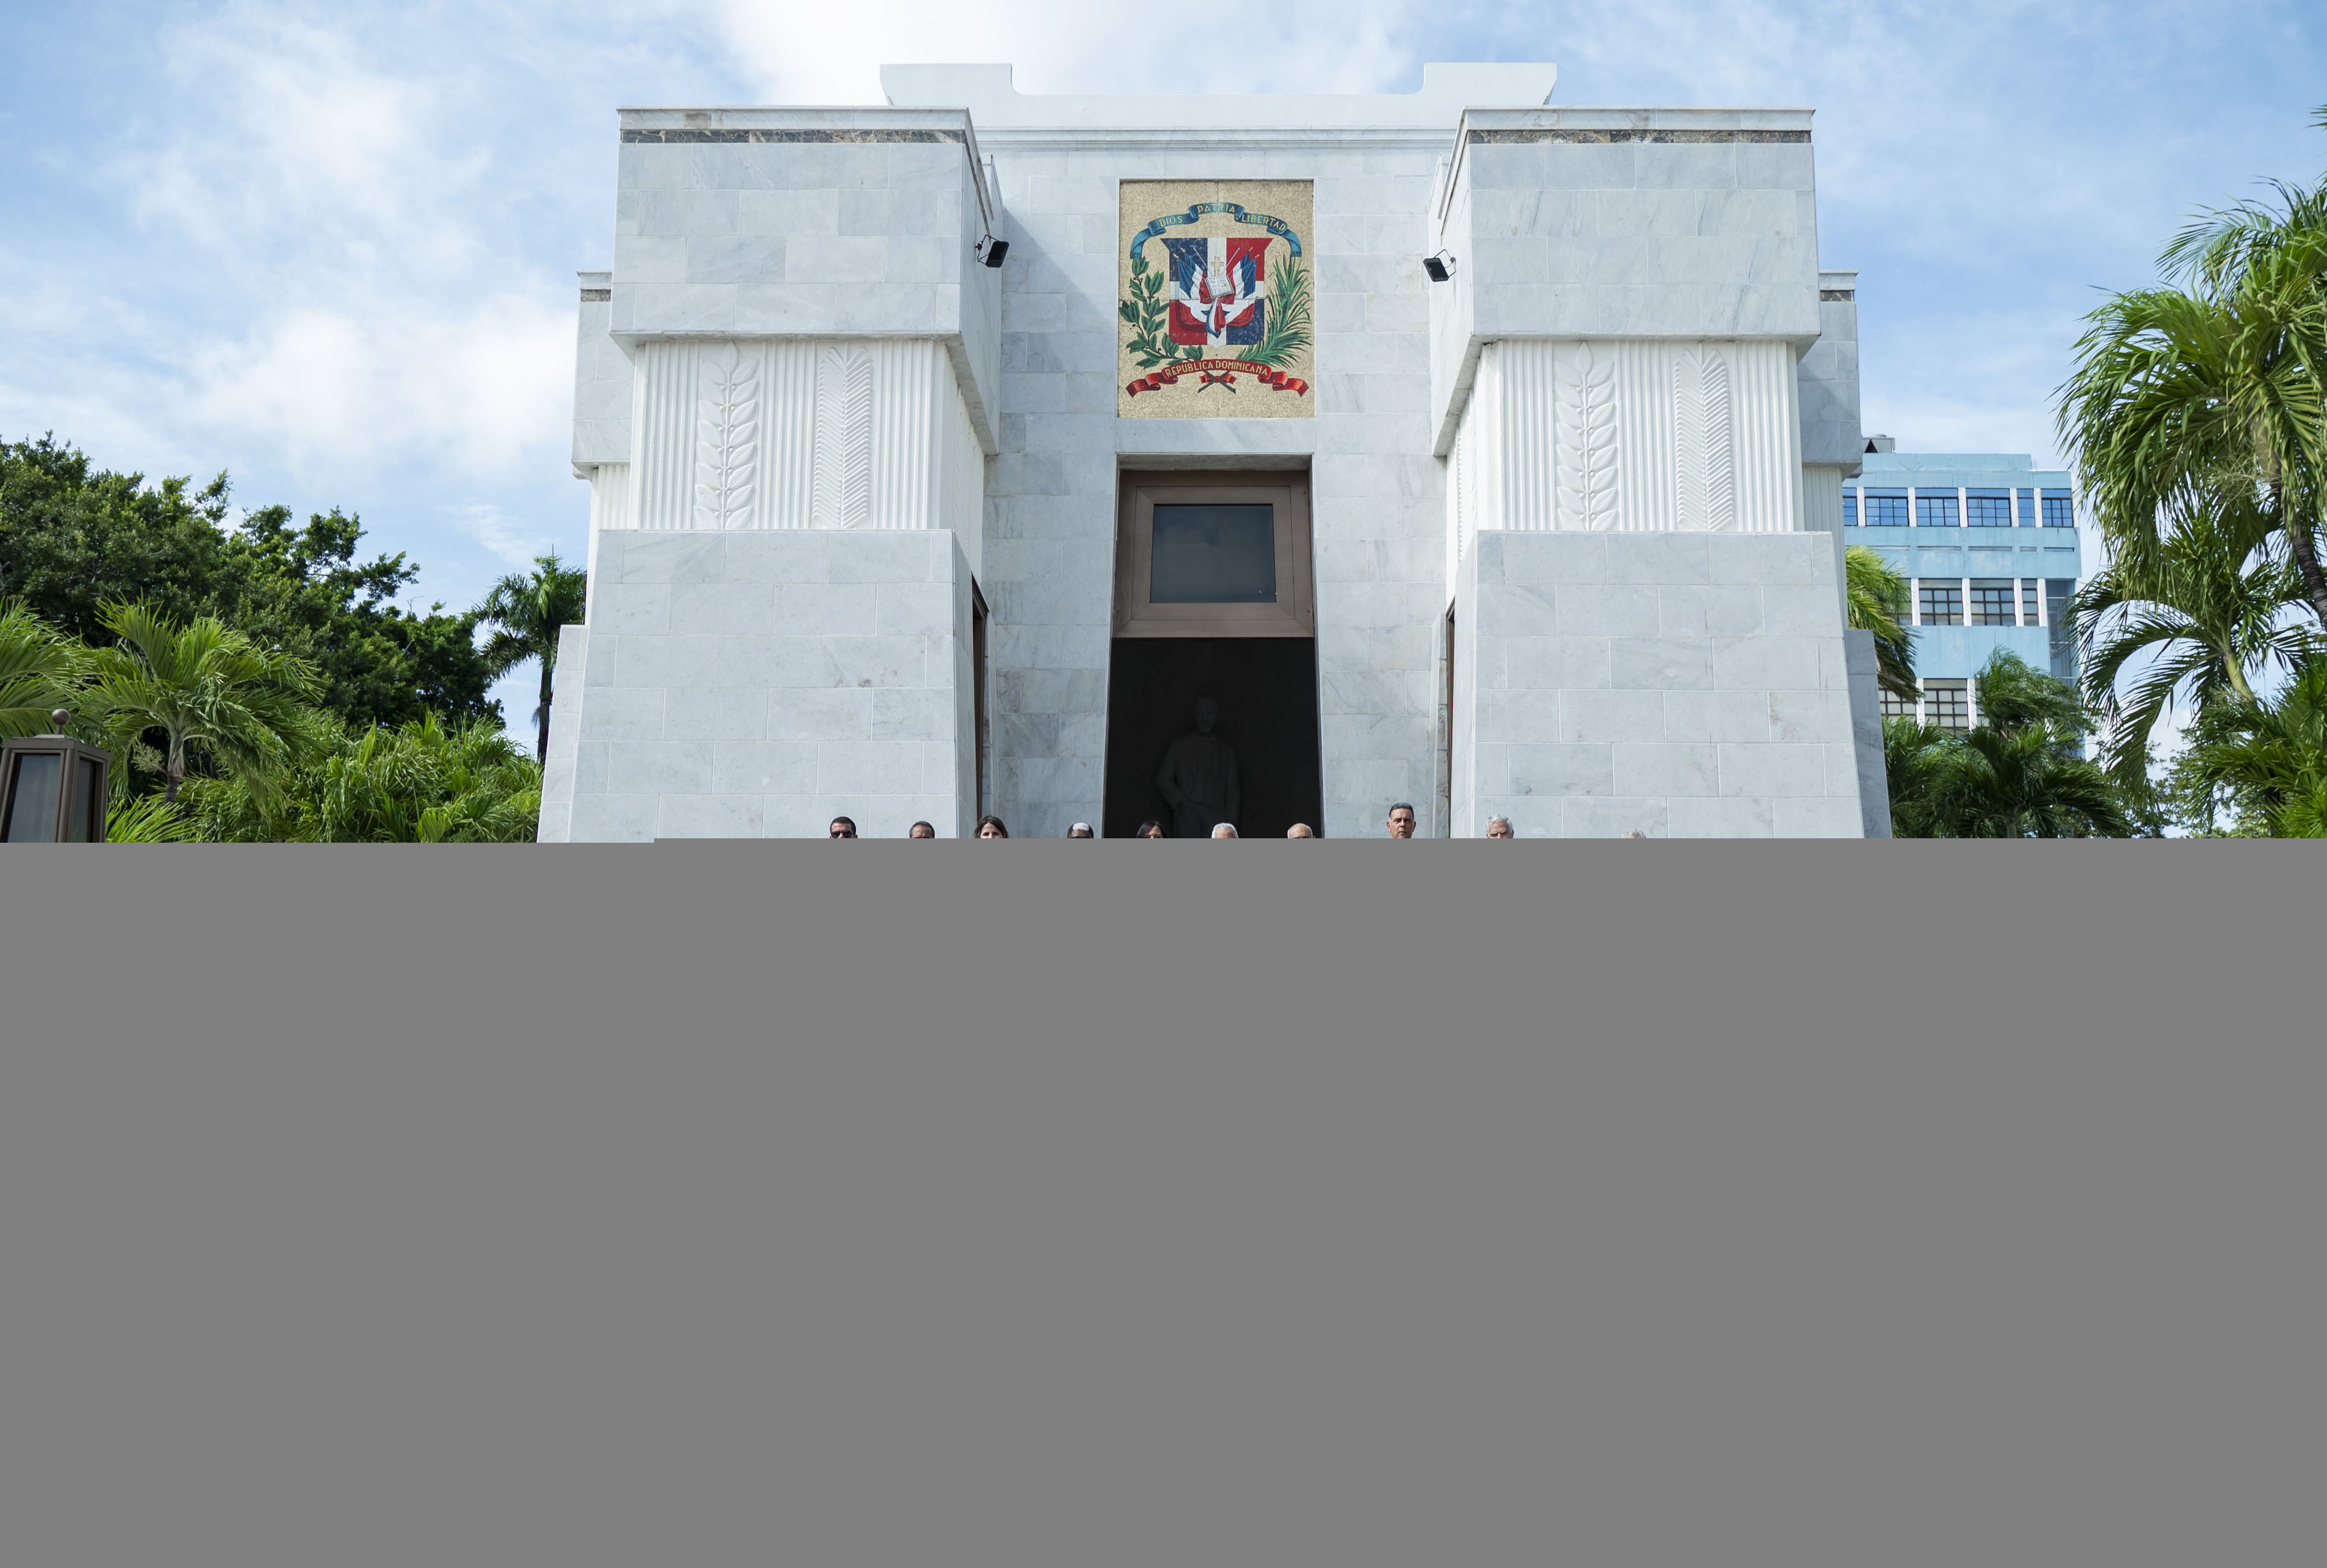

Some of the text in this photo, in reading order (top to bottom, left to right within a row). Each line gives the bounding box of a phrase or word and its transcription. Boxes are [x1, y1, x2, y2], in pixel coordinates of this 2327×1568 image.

[1159, 204, 1286, 230] DIOS PATRIA LIBERTAD
[1165, 360, 1267, 377] REPUBLICA DOMINICANA
